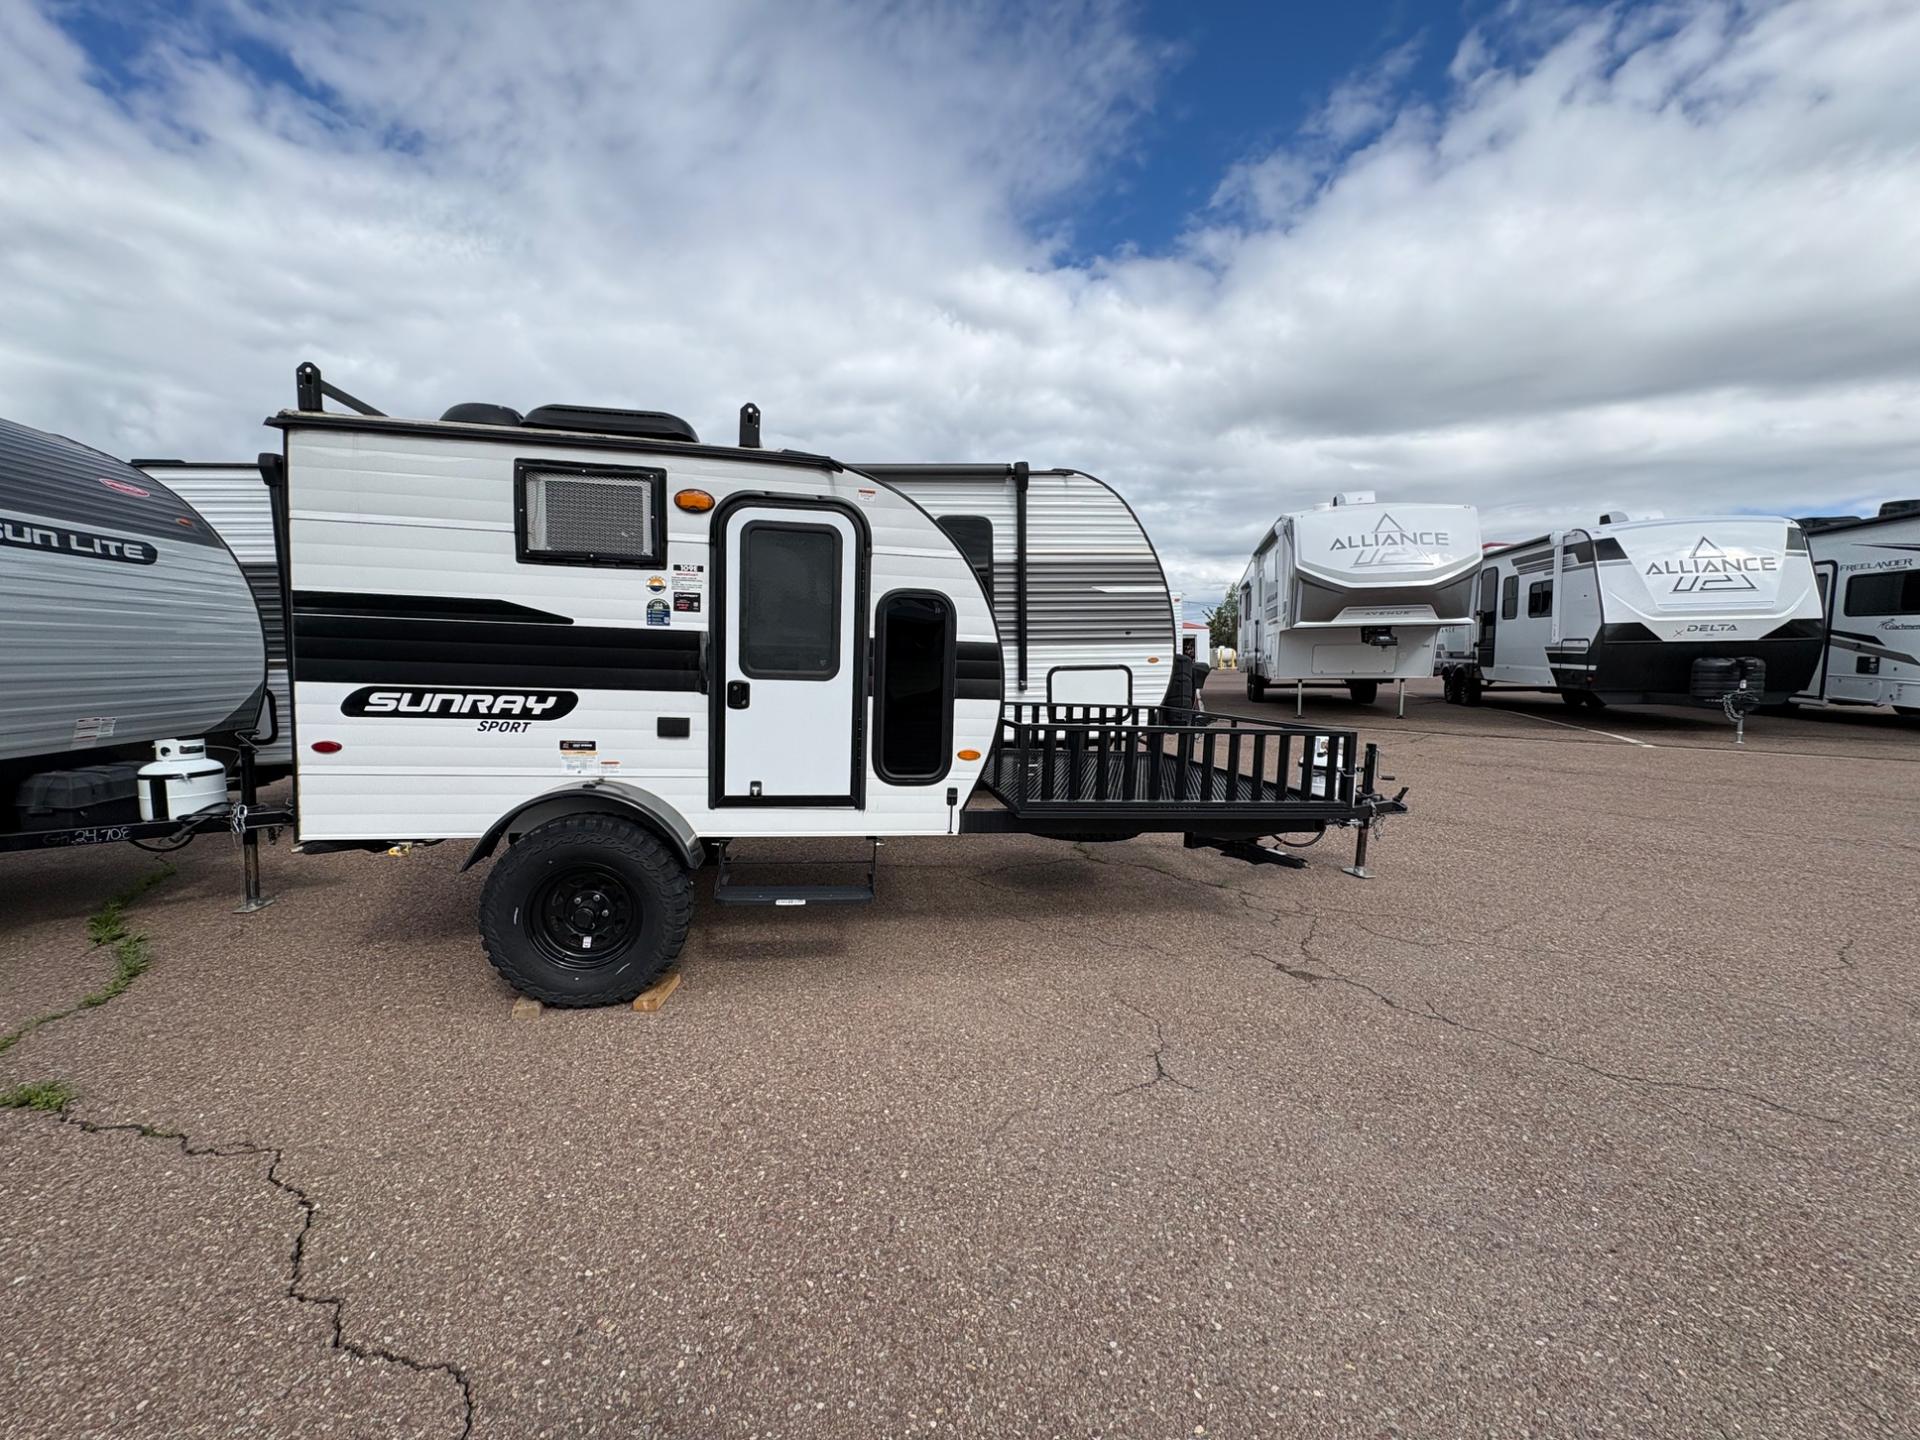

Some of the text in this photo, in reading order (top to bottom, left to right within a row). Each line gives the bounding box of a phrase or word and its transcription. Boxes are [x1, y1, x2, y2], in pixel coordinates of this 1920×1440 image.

[69, 534, 145, 560] LITE
[1329, 532, 1450, 551] ALLIANCE
[1645, 557, 1777, 575] ALLIANCE
[1840, 558, 1913, 572] FREELANDER
[1686, 623, 1738, 632] DELTA
[364, 692, 557, 715] SUNRAY
[477, 720, 532, 733] SPORT
